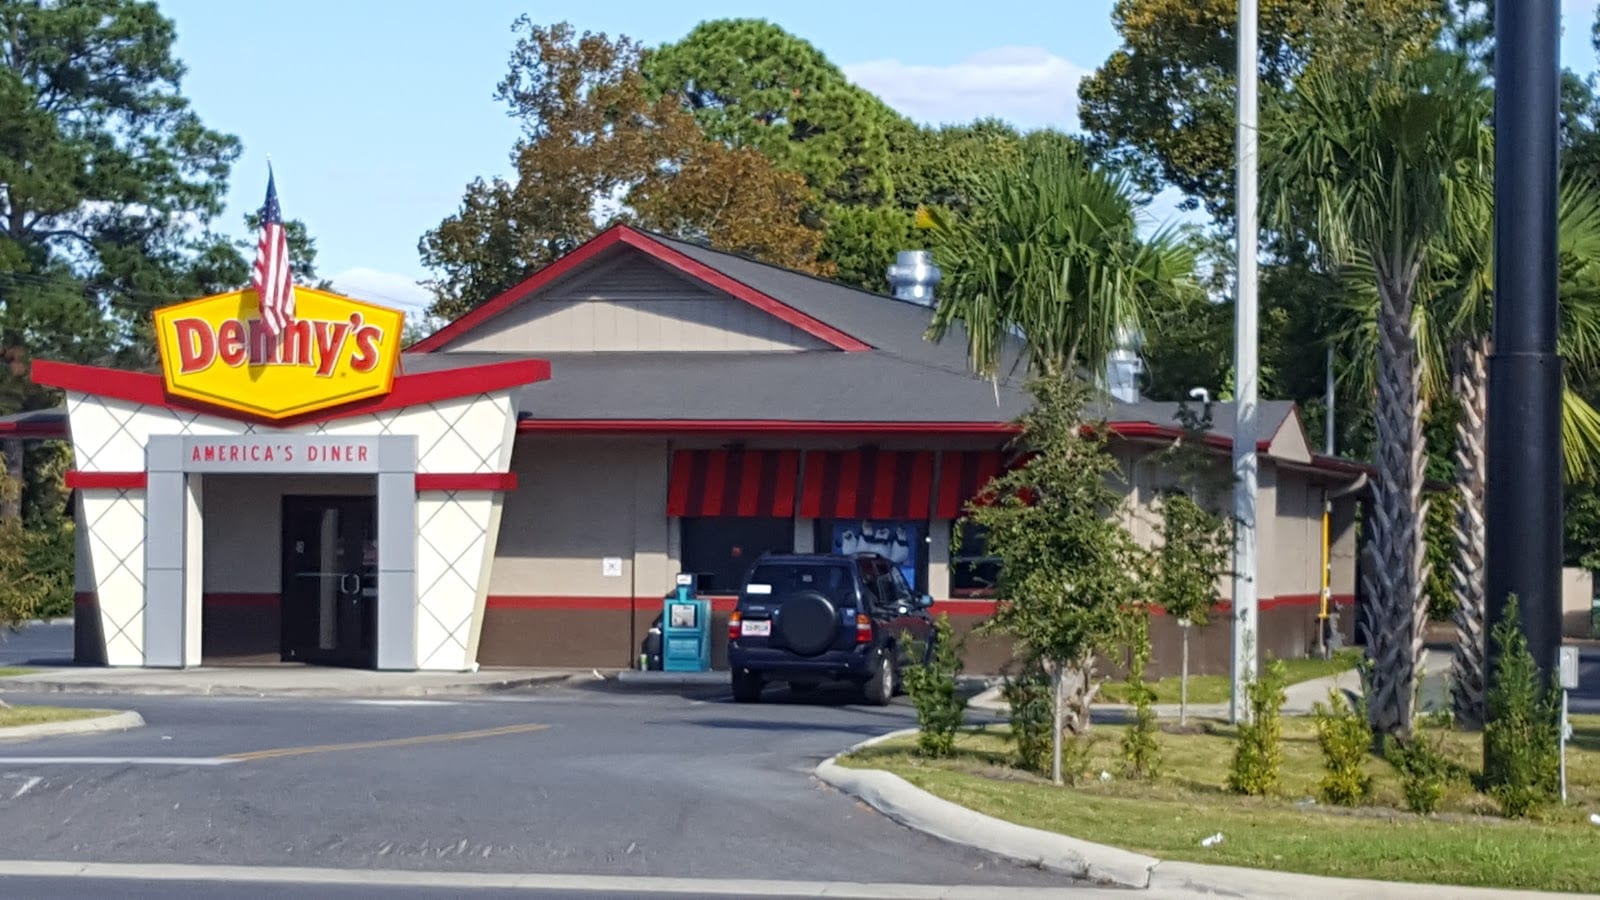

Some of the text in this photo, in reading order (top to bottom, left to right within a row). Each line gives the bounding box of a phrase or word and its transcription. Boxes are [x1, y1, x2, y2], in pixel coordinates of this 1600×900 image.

[174, 312, 383, 377] Denny's
[192, 445, 368, 462] AMERICA'S DINER
